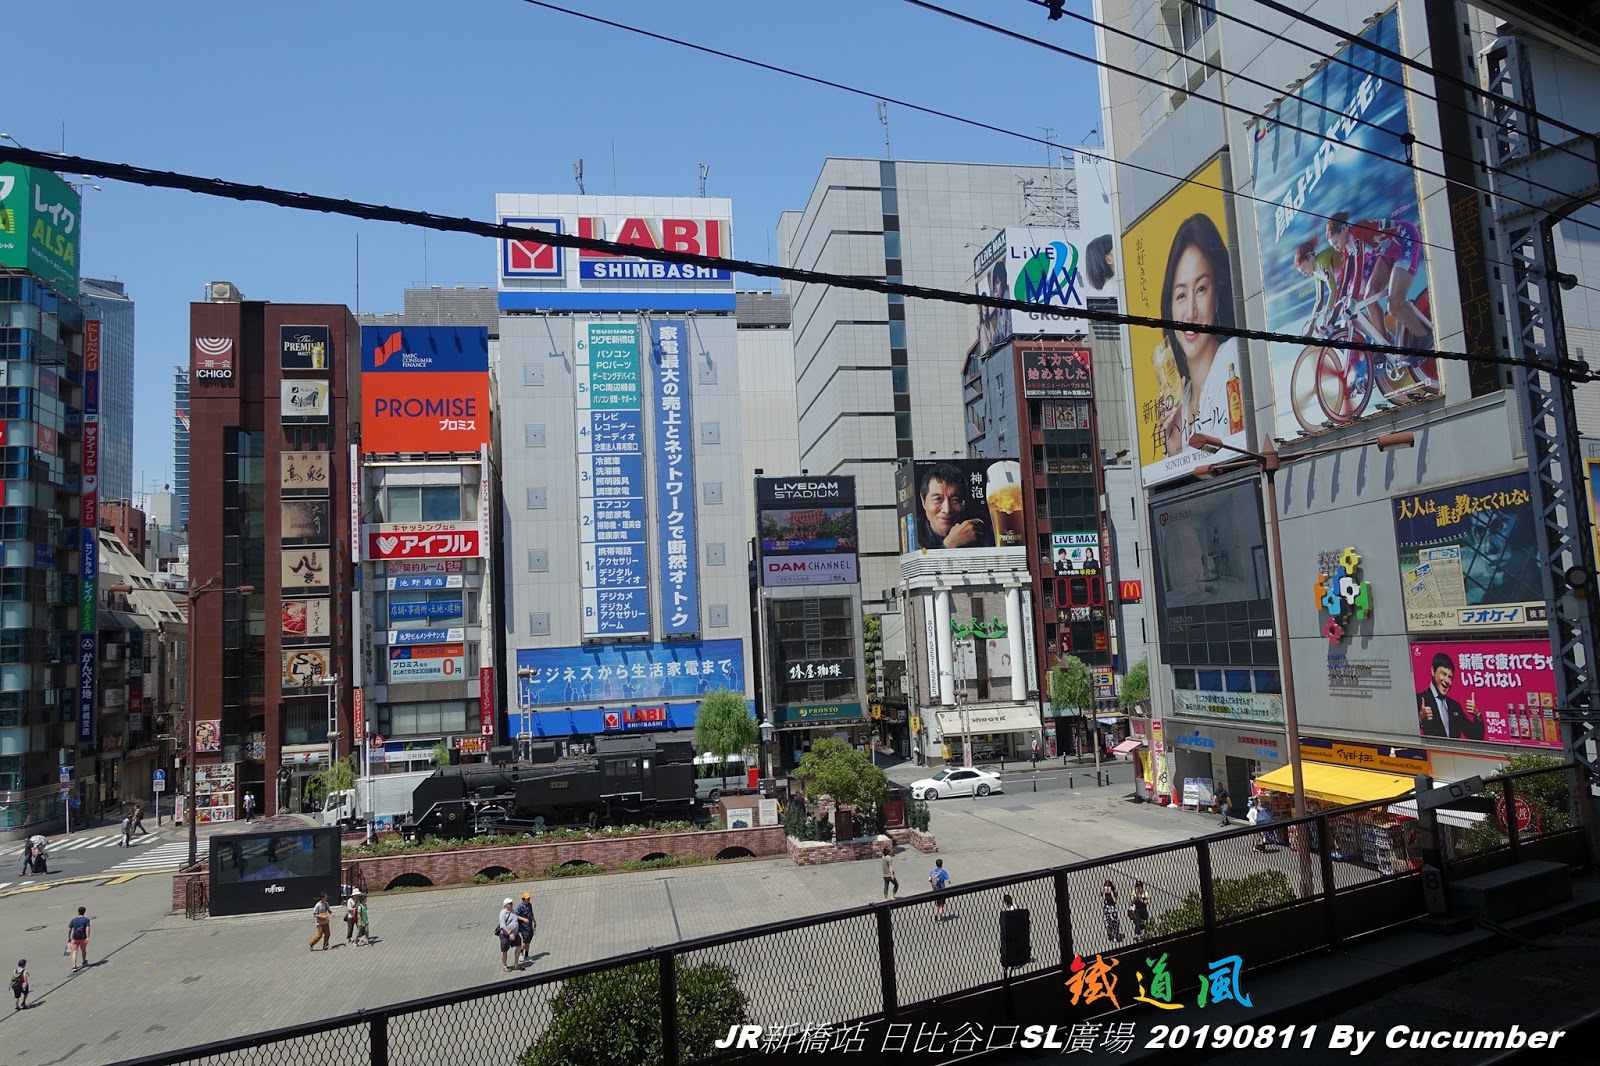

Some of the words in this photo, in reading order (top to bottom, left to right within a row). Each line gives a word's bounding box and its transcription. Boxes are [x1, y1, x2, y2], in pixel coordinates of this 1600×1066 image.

[1275, 70, 1383, 245] 顔より太もも。
[35, 183, 75, 234] レイク
[32, 218, 74, 267] ALSA
[578, 217, 724, 259] LABI
[1011, 246, 1055, 260] LiVE
[594, 263, 718, 279] SHIMBASHI
[1024, 267, 1082, 306] MAX
[591, 335, 635, 344] ツクモ新橋店
[284, 341, 325, 351] PREMIUM
[577, 340, 588, 350] 6F
[597, 350, 630, 358] パソコン
[197, 360, 231, 368] 一期一会
[1038, 353, 1075, 366] オカマ
[596, 361, 632, 370] PCパーツ
[196, 369, 232, 378] ICHIGO
[592, 372, 637, 380] ゲーミングデバイス
[1028, 368, 1087, 380] 始めました
[578, 383, 589, 393] 5F
[593, 383, 637, 392] PC周辺機器
[375, 398, 476, 417] PROMISE
[1142, 394, 1175, 424] 新橋の
[594, 413, 619, 421] テレビ
[439, 419, 477, 431] プロミス
[594, 422, 636, 430] レコーダー
[579, 426, 591, 437] 4F
[1151, 406, 1229, 461] 角ハイボール。
[594, 433, 636, 441] オーディオ
[86, 436, 96, 467] アイフル
[595, 457, 621, 465] 冷蔵庫
[1165, 456, 1191, 472] SUNTORY
[581, 471, 592, 482] 3F
[596, 467, 621, 476] 洗濯機
[659, 326, 689, 627] 家電最大の売上とネットワークで断然オ・ト・ク
[596, 477, 630, 486] 照明器具
[596, 487, 630, 496] 調理家電
[774, 490, 839, 498] STADIUM
[86, 500, 94, 520] アコム
[597, 511, 631, 519] 季節家電
[582, 516, 593, 526] 2F
[393, 523, 456, 532] キャッシングなら
[598, 531, 628, 539] 健康家電
[1075, 534, 1097, 543] MAX
[400, 535, 473, 554] アイフル
[598, 547, 632, 556] 携帯電話
[85, 543, 93, 574] セントラル
[598, 557, 639, 565] アクセサリー
[403, 563, 444, 572] 契約ルーム
[585, 561, 595, 571] 1F
[769, 563, 806, 572] DAM
[808, 561, 852, 571] CHANNEL
[599, 568, 632, 576] デジタル
[400, 578, 443, 587] 池野商店
[599, 576, 641, 584] オーディオ
[84, 582, 93, 602] レイク
[600, 592, 634, 600] デジカメ
[586, 607, 596, 617] B1
[600, 603, 631, 611] デジカメ
[600, 611, 646, 619] アクセサリー
[1462, 608, 1519, 623] アオケイ
[398, 632, 446, 641] 池野ビルメンテナンス
[81, 653, 93, 699] かんべ土地
[529, 658, 732, 684] ビジネスから生活家電まで
[1461, 672, 1522, 688] いられない
[82, 704, 91, 736] 新橋支店
[623, 708, 667, 722] LABI
[1380, 759, 1406, 768] Matsumoto
[1449, 781, 1472, 798] 0.5
[265, 884, 285, 894] FUJITSU
